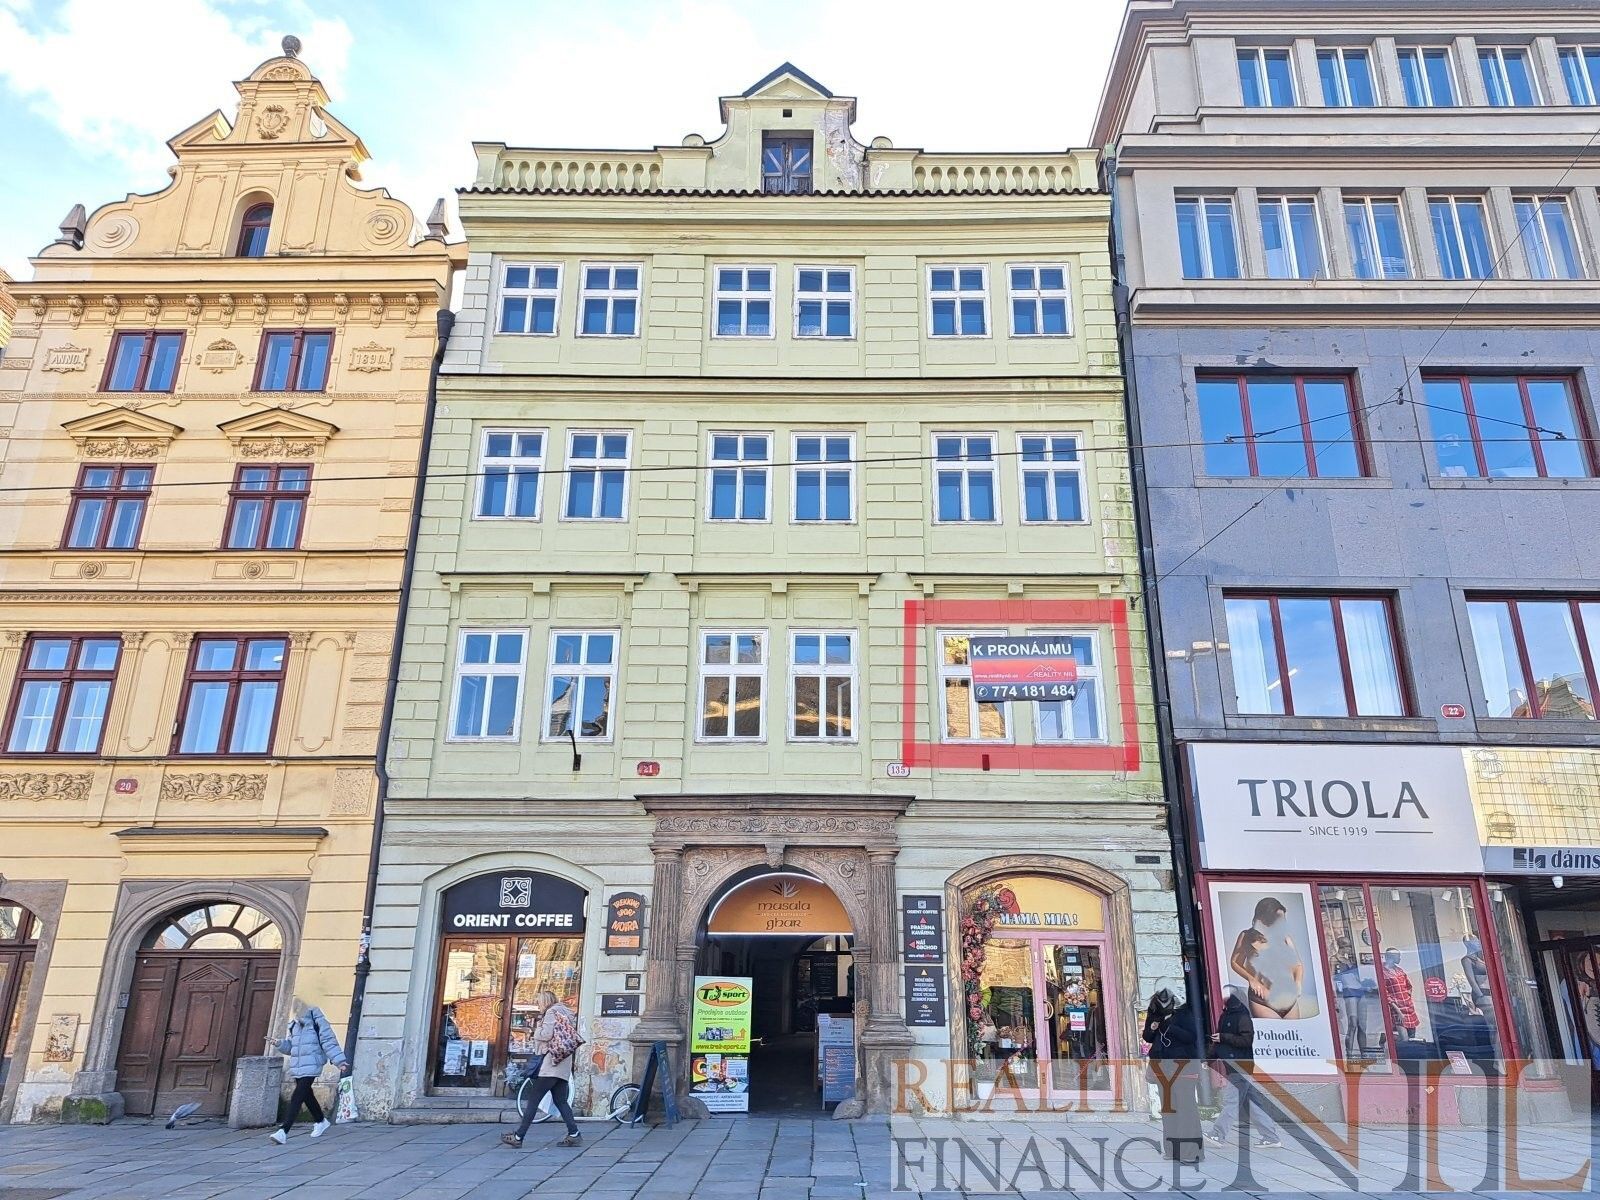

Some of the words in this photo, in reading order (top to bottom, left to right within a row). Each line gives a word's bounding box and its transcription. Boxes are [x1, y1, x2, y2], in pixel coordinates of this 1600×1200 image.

[973, 644, 984, 656] K
[987, 641, 1072, 656] PRONÁJMU
[991, 685, 1018, 697] 774
[1022, 685, 1046, 697] 181
[1050, 684, 1075, 696] 484
[1448, 707, 1460, 715] 22
[891, 765, 906, 775] 135
[120, 782, 132, 791] 20
[1237, 779, 1430, 819] TRIOLA
[1308, 826, 1340, 836] SINCE
[1343, 826, 1368, 837] 1919
[758, 900, 811, 911] masala
[453, 914, 510, 927] ORIENT
[515, 914, 573, 927] COFFEE
[1000, 912, 1041, 926] MAMA
[722, 991, 748, 999] sport
